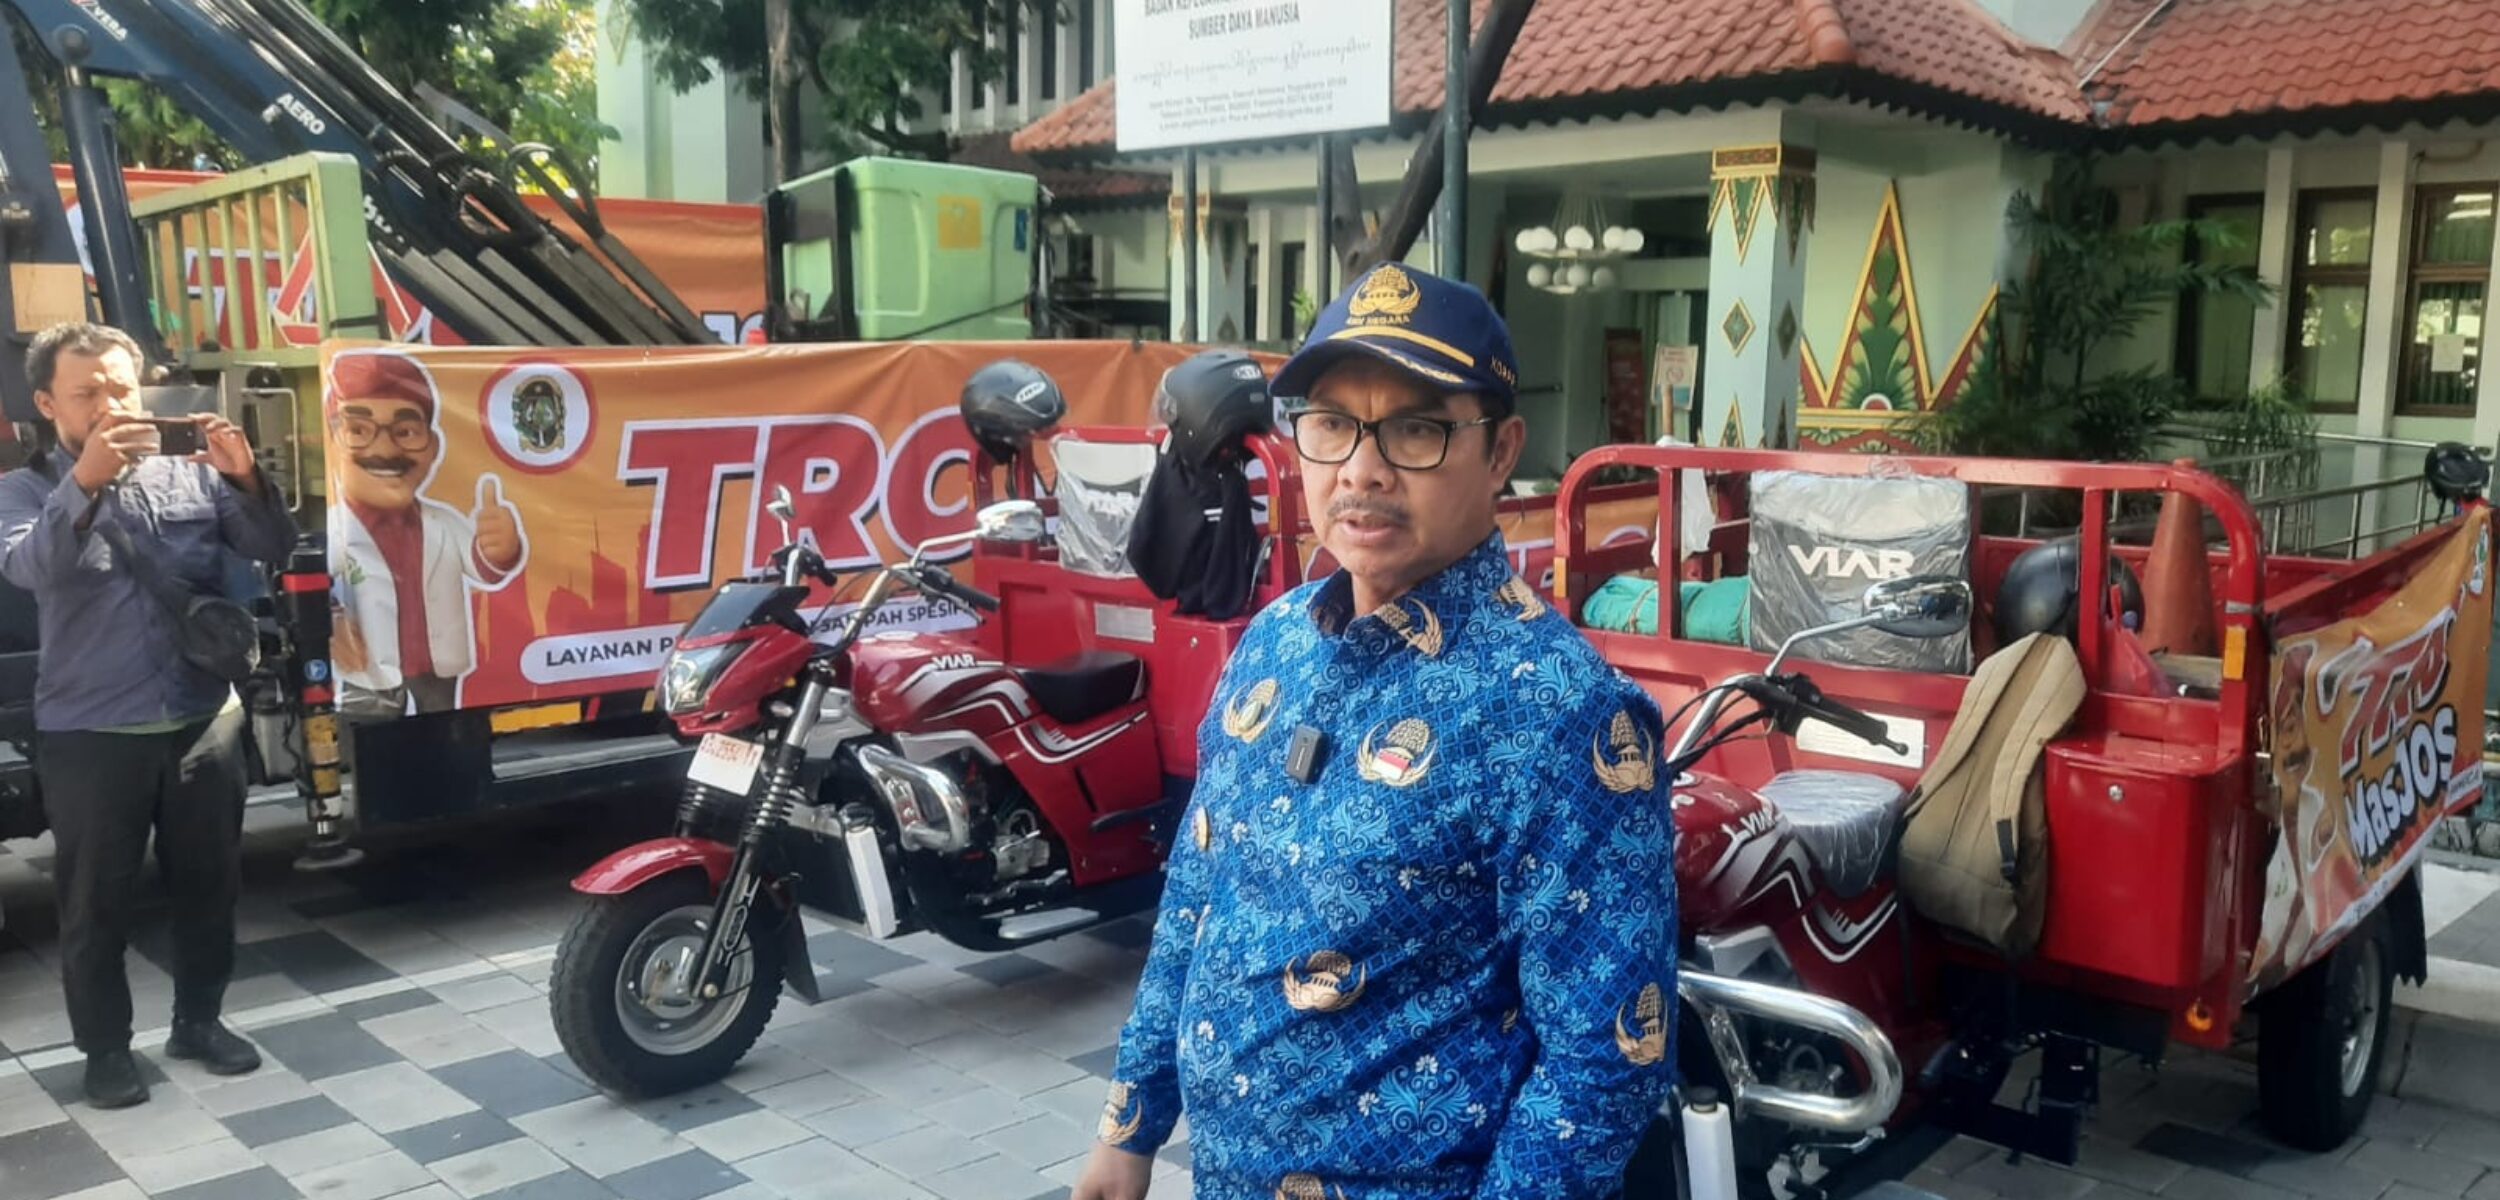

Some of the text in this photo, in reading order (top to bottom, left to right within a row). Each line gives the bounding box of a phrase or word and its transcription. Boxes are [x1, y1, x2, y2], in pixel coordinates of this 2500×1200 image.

[1229, 9, 1253, 33] DAYA
[1255, 3, 1300, 28] MANUSIA
[276, 92, 326, 135] AERO
[1787, 544, 1915, 579] VIAR
[819, 607, 903, 632] SAPAH
[546, 639, 653, 667] LAYANAN
[932, 653, 976, 670] VIAR
